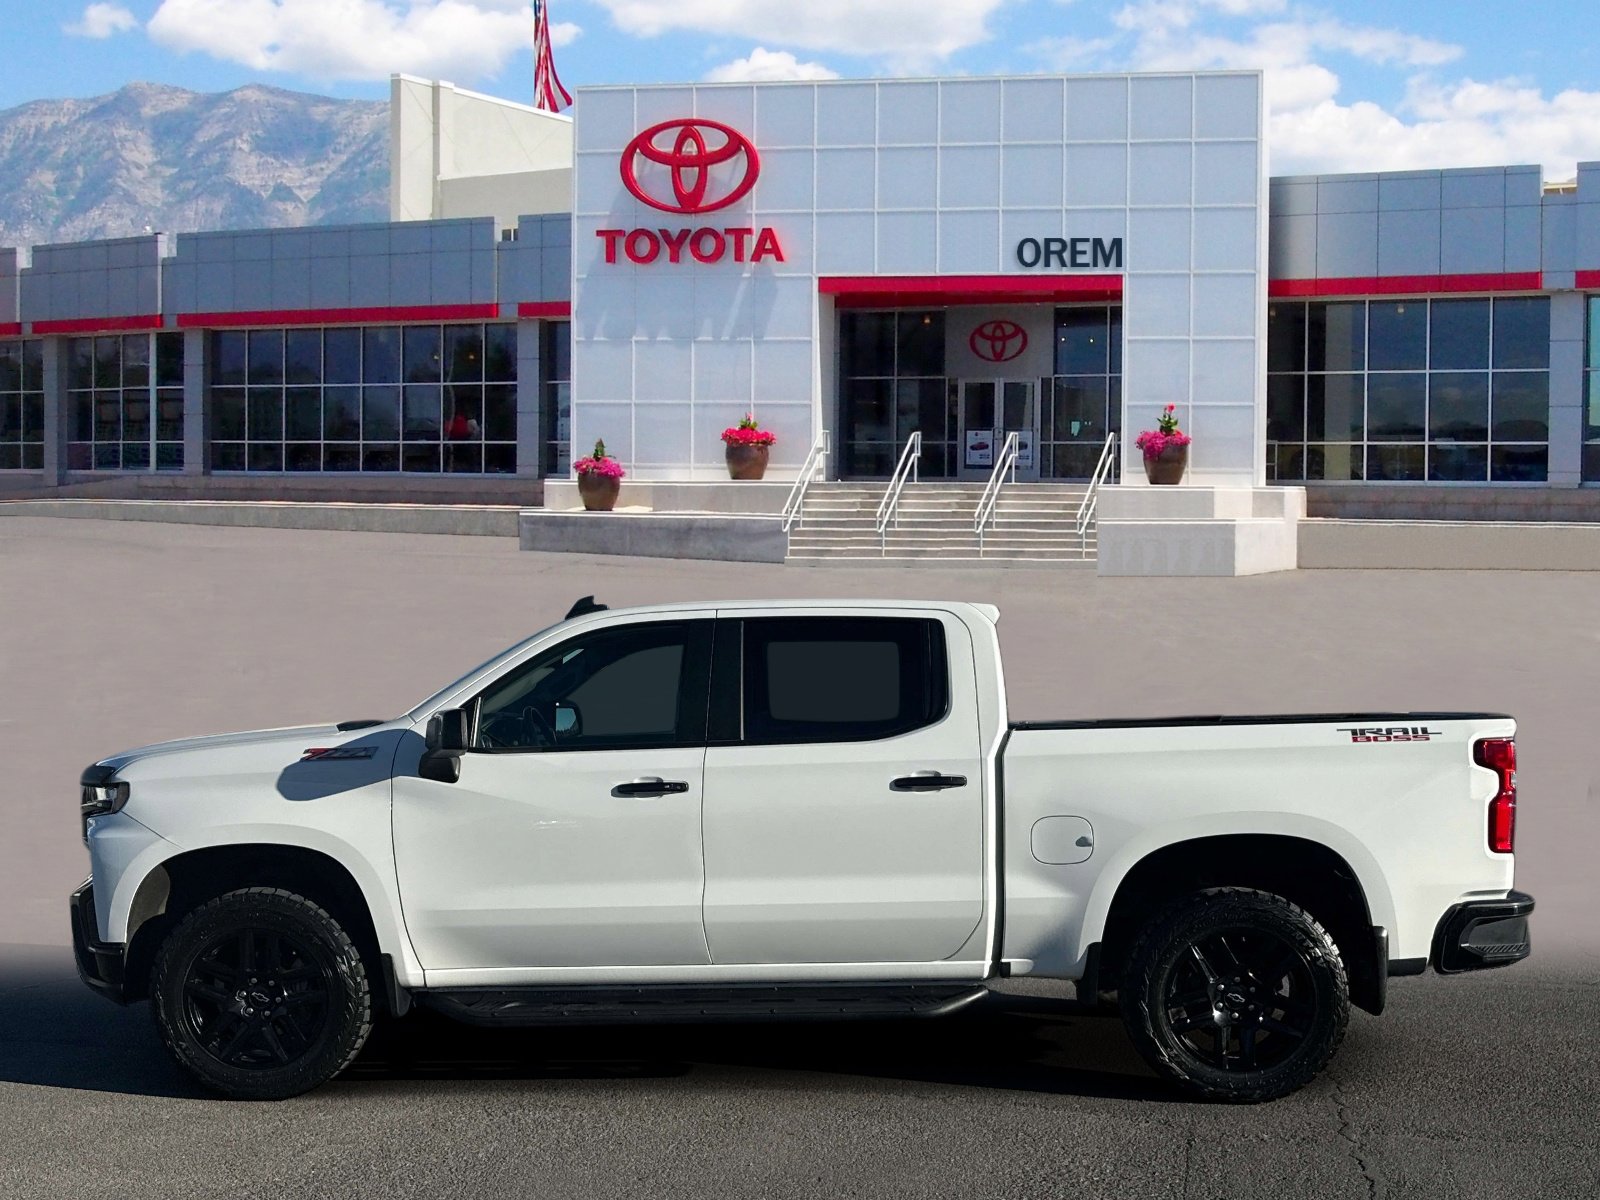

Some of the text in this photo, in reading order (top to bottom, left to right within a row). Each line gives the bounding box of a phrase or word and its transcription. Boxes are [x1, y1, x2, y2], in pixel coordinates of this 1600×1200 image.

[595, 227, 785, 264] TOYOTA
[1016, 237, 1123, 268] OREM
[1336, 727, 1442, 736] TRAIL
[1351, 734, 1431, 743] BOSS
